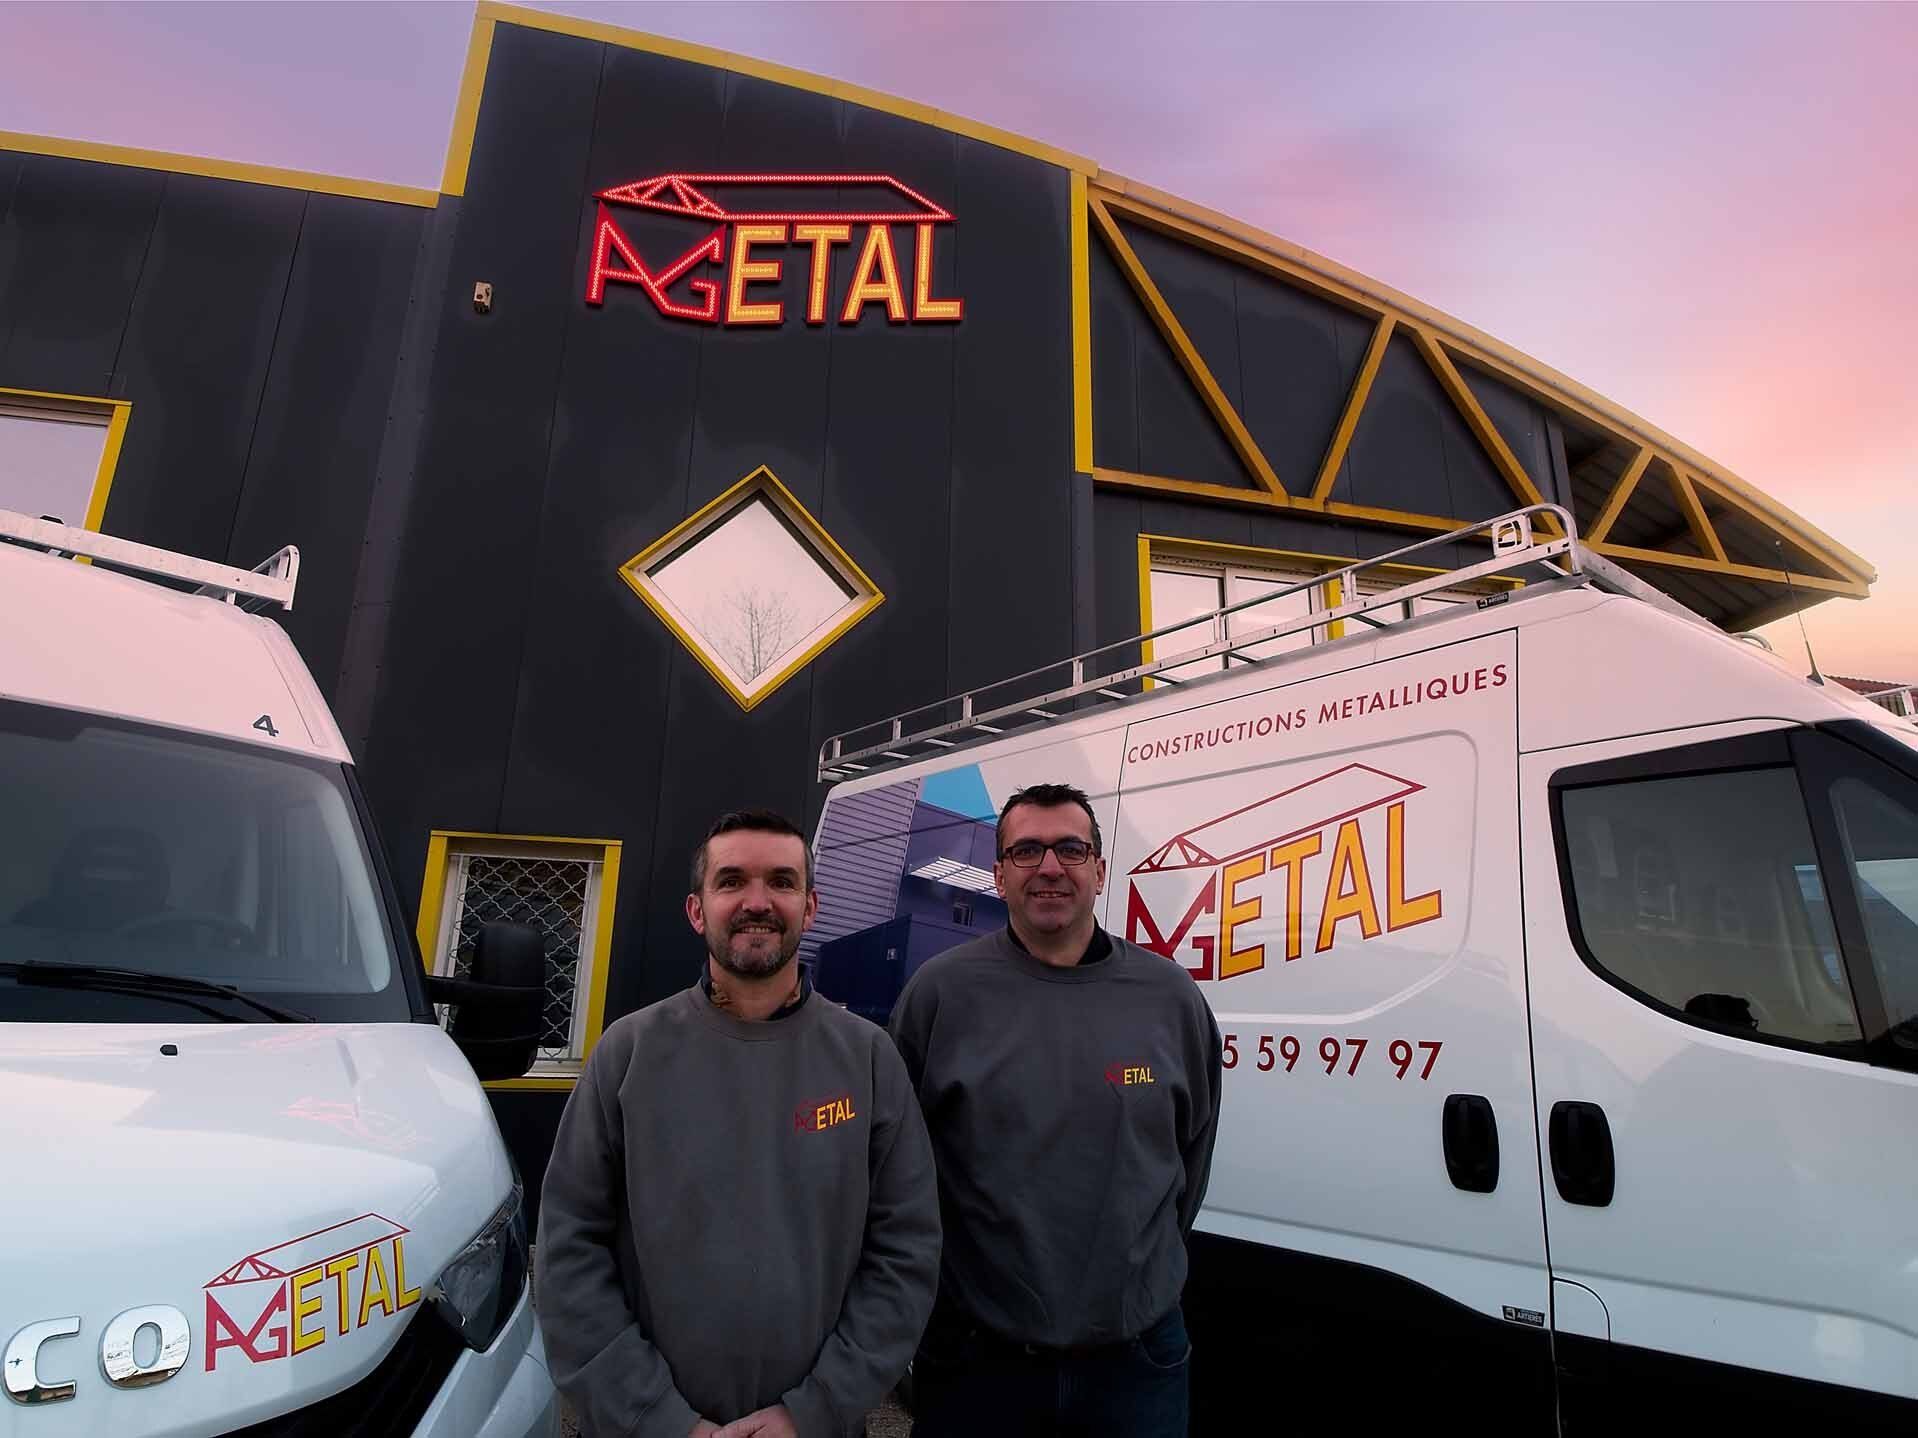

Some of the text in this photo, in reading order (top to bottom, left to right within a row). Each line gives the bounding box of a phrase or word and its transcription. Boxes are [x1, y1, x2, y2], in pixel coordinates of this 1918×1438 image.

[252, 714, 279, 737] 4
[1127, 663, 1508, 764] CONSTRUCTIONS METALLIQUES
[1256, 1035, 1301, 1073] 59
[1319, 1037, 1369, 1077] 97
[1388, 1039, 1444, 1081] 97
